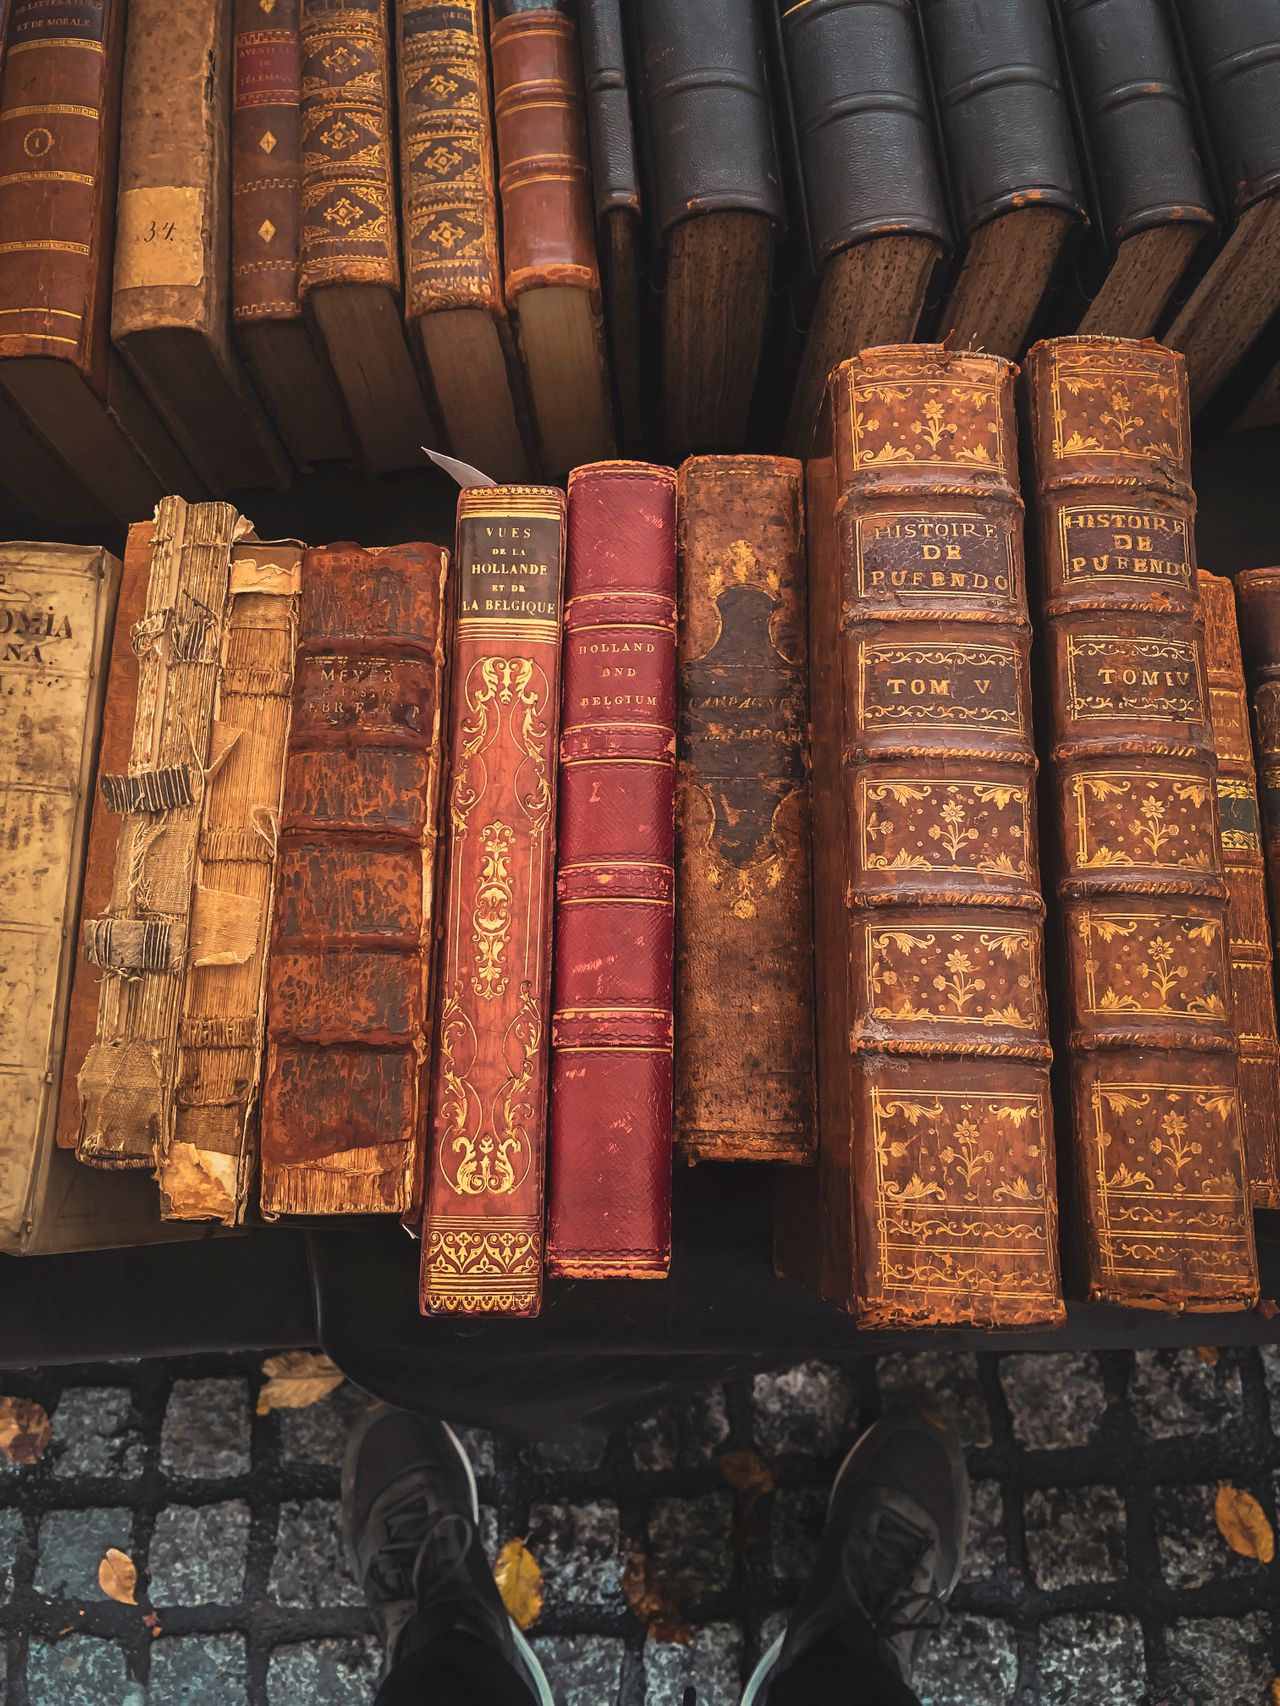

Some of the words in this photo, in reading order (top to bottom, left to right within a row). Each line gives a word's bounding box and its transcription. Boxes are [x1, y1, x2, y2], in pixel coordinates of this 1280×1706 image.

[31, 19, 44, 28] DE
[47, 17, 91, 27] MORALE
[1065, 513, 1186, 535] HISTOIRE
[485, 527, 533, 538] VUES
[874, 522, 998, 540] HISTOIRE
[1111, 533, 1154, 552] DE
[492, 547, 507, 556] DE
[512, 547, 526, 556] LA
[920, 544, 963, 560] DE
[471, 563, 548, 576] HOLLANDE
[492, 584, 505, 593] ET
[511, 584, 526, 593] DE
[462, 600, 479, 611] LA
[485, 599, 556, 615] BELGIQUE
[578, 642, 656, 655] HOLLAND
[600, 666, 637, 678] AND
[887, 678, 951, 696] TOM
[973, 679, 991, 694] V
[579, 694, 658, 708] BELGIUM
